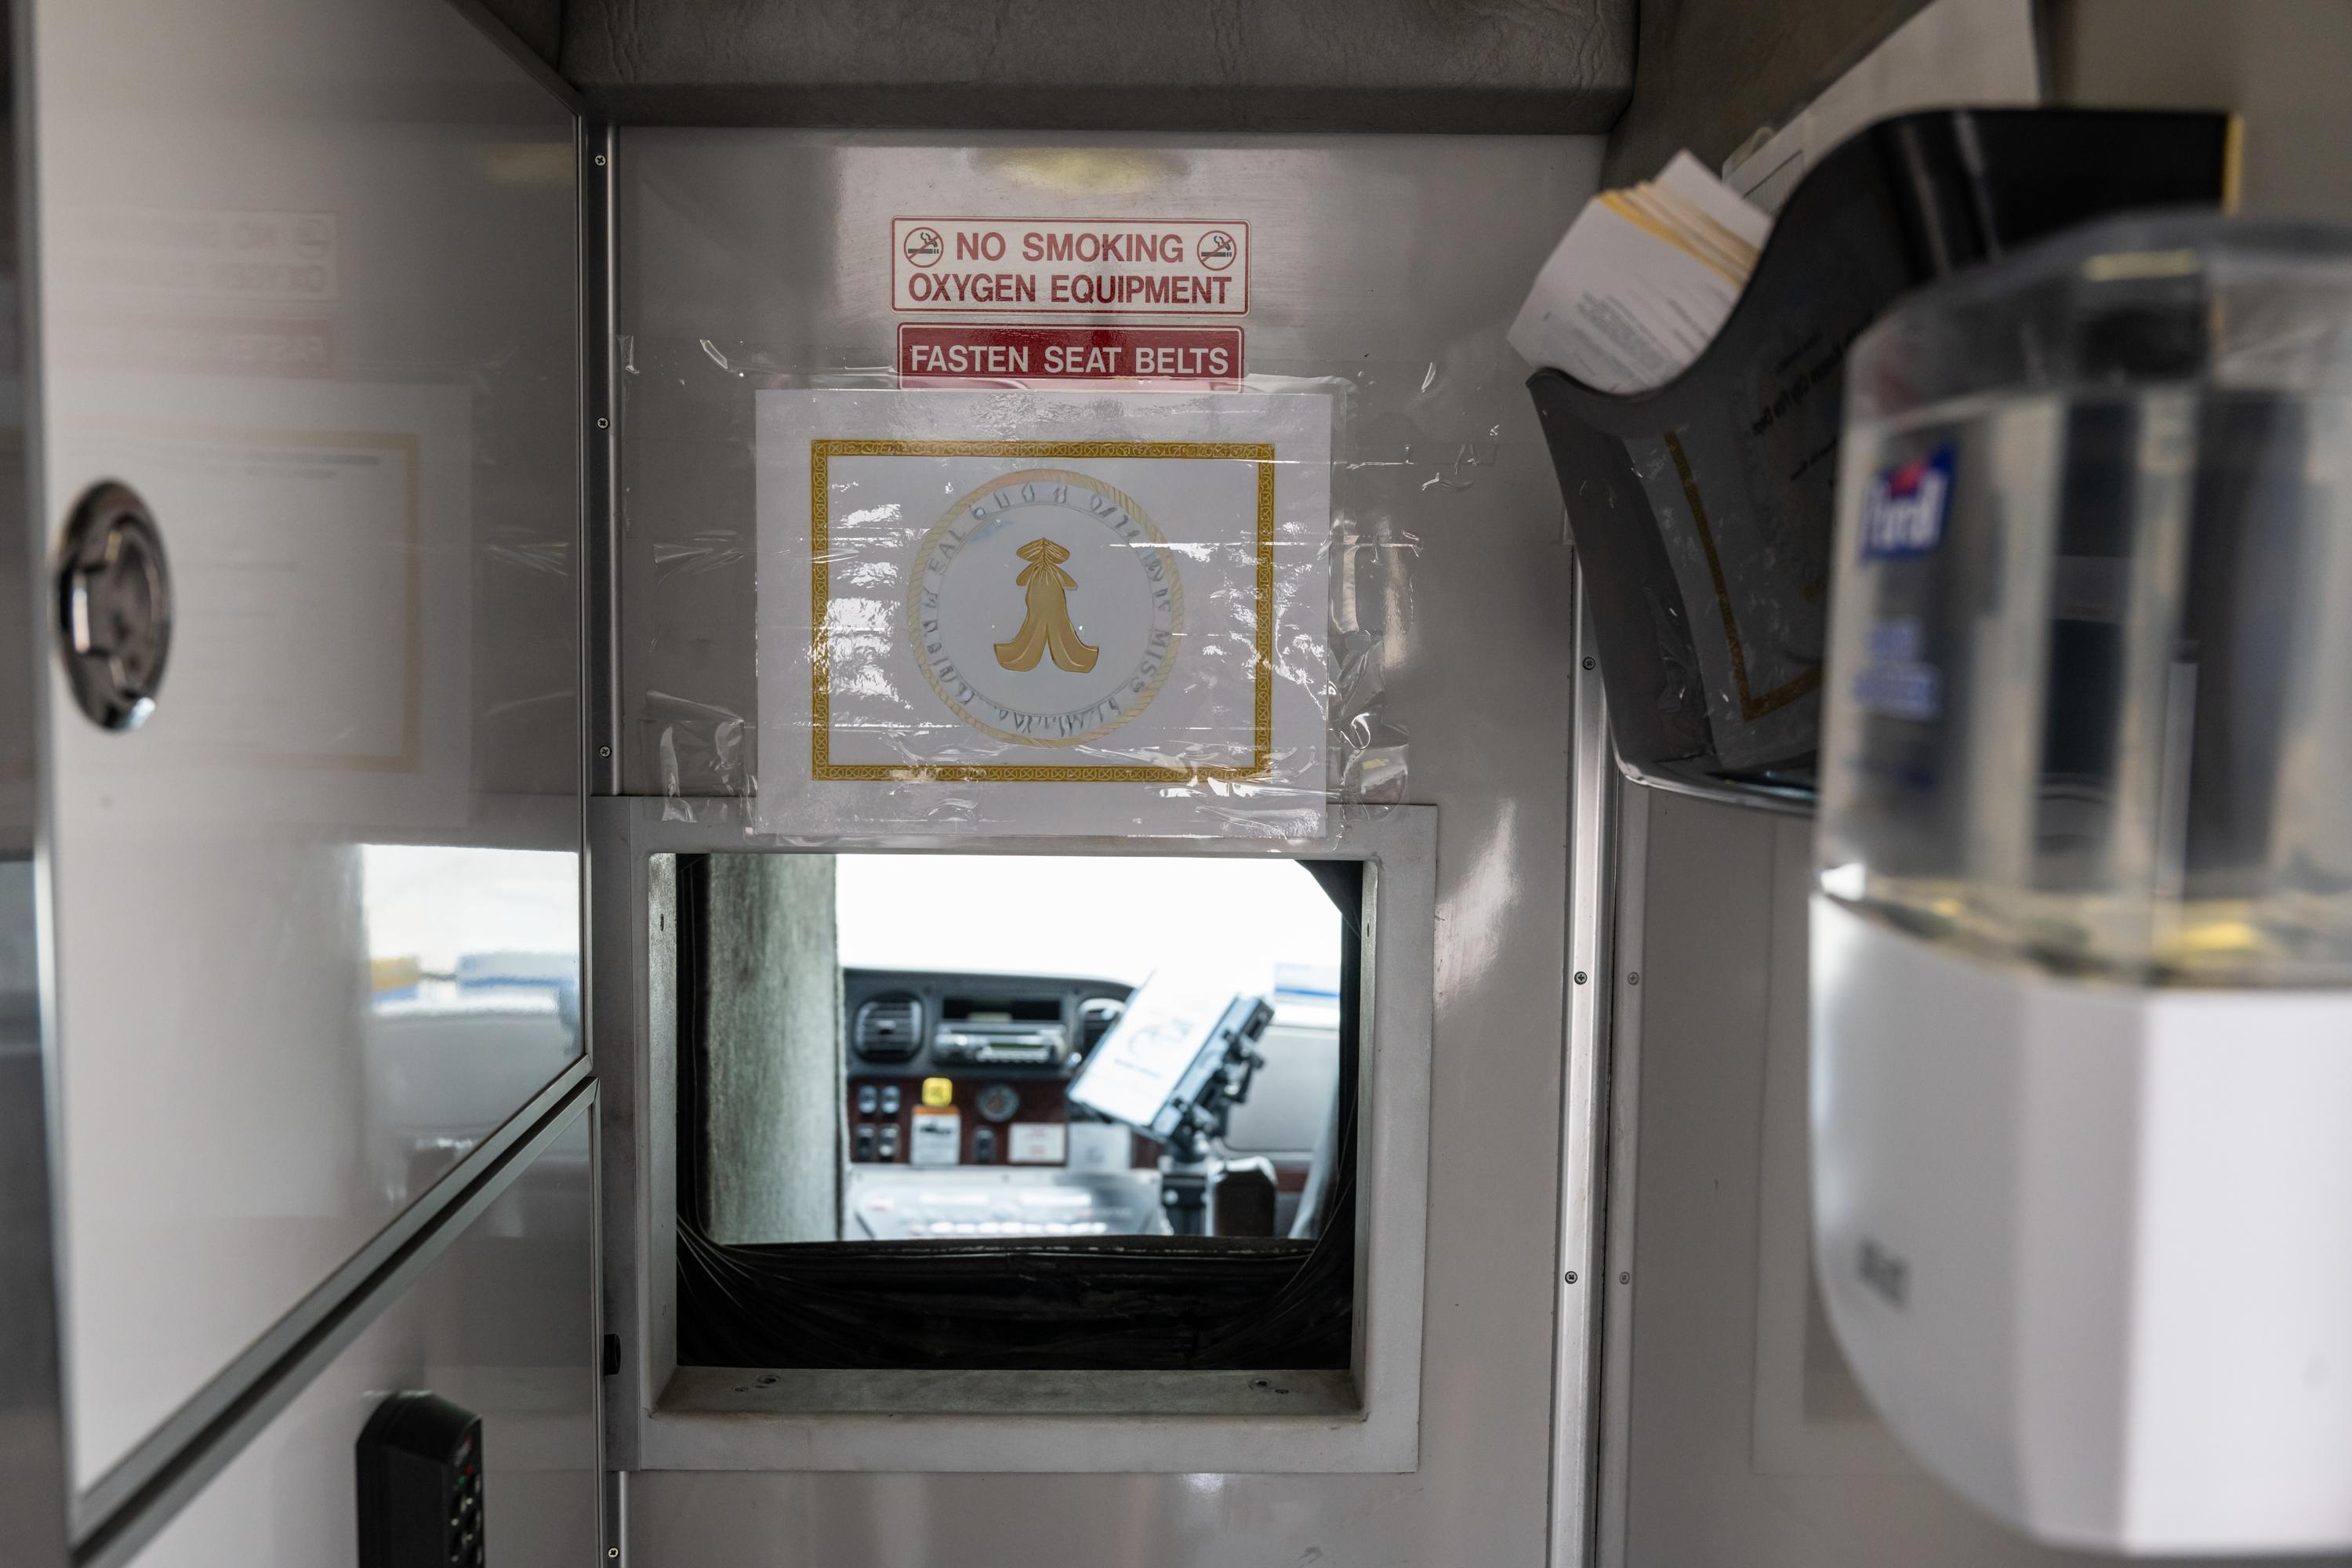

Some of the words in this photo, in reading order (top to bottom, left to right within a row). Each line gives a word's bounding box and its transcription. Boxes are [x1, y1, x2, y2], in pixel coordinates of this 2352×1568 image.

[956, 232, 1006, 260] NO
[1022, 233, 1184, 262] SMOKING
[909, 273, 1036, 302] OXYGEN
[1051, 274, 1232, 304] EQUIPMENT
[911, 345, 1029, 372] FASTEN
[1044, 345, 1121, 373] SEAT
[1135, 347, 1229, 374] BELTS
